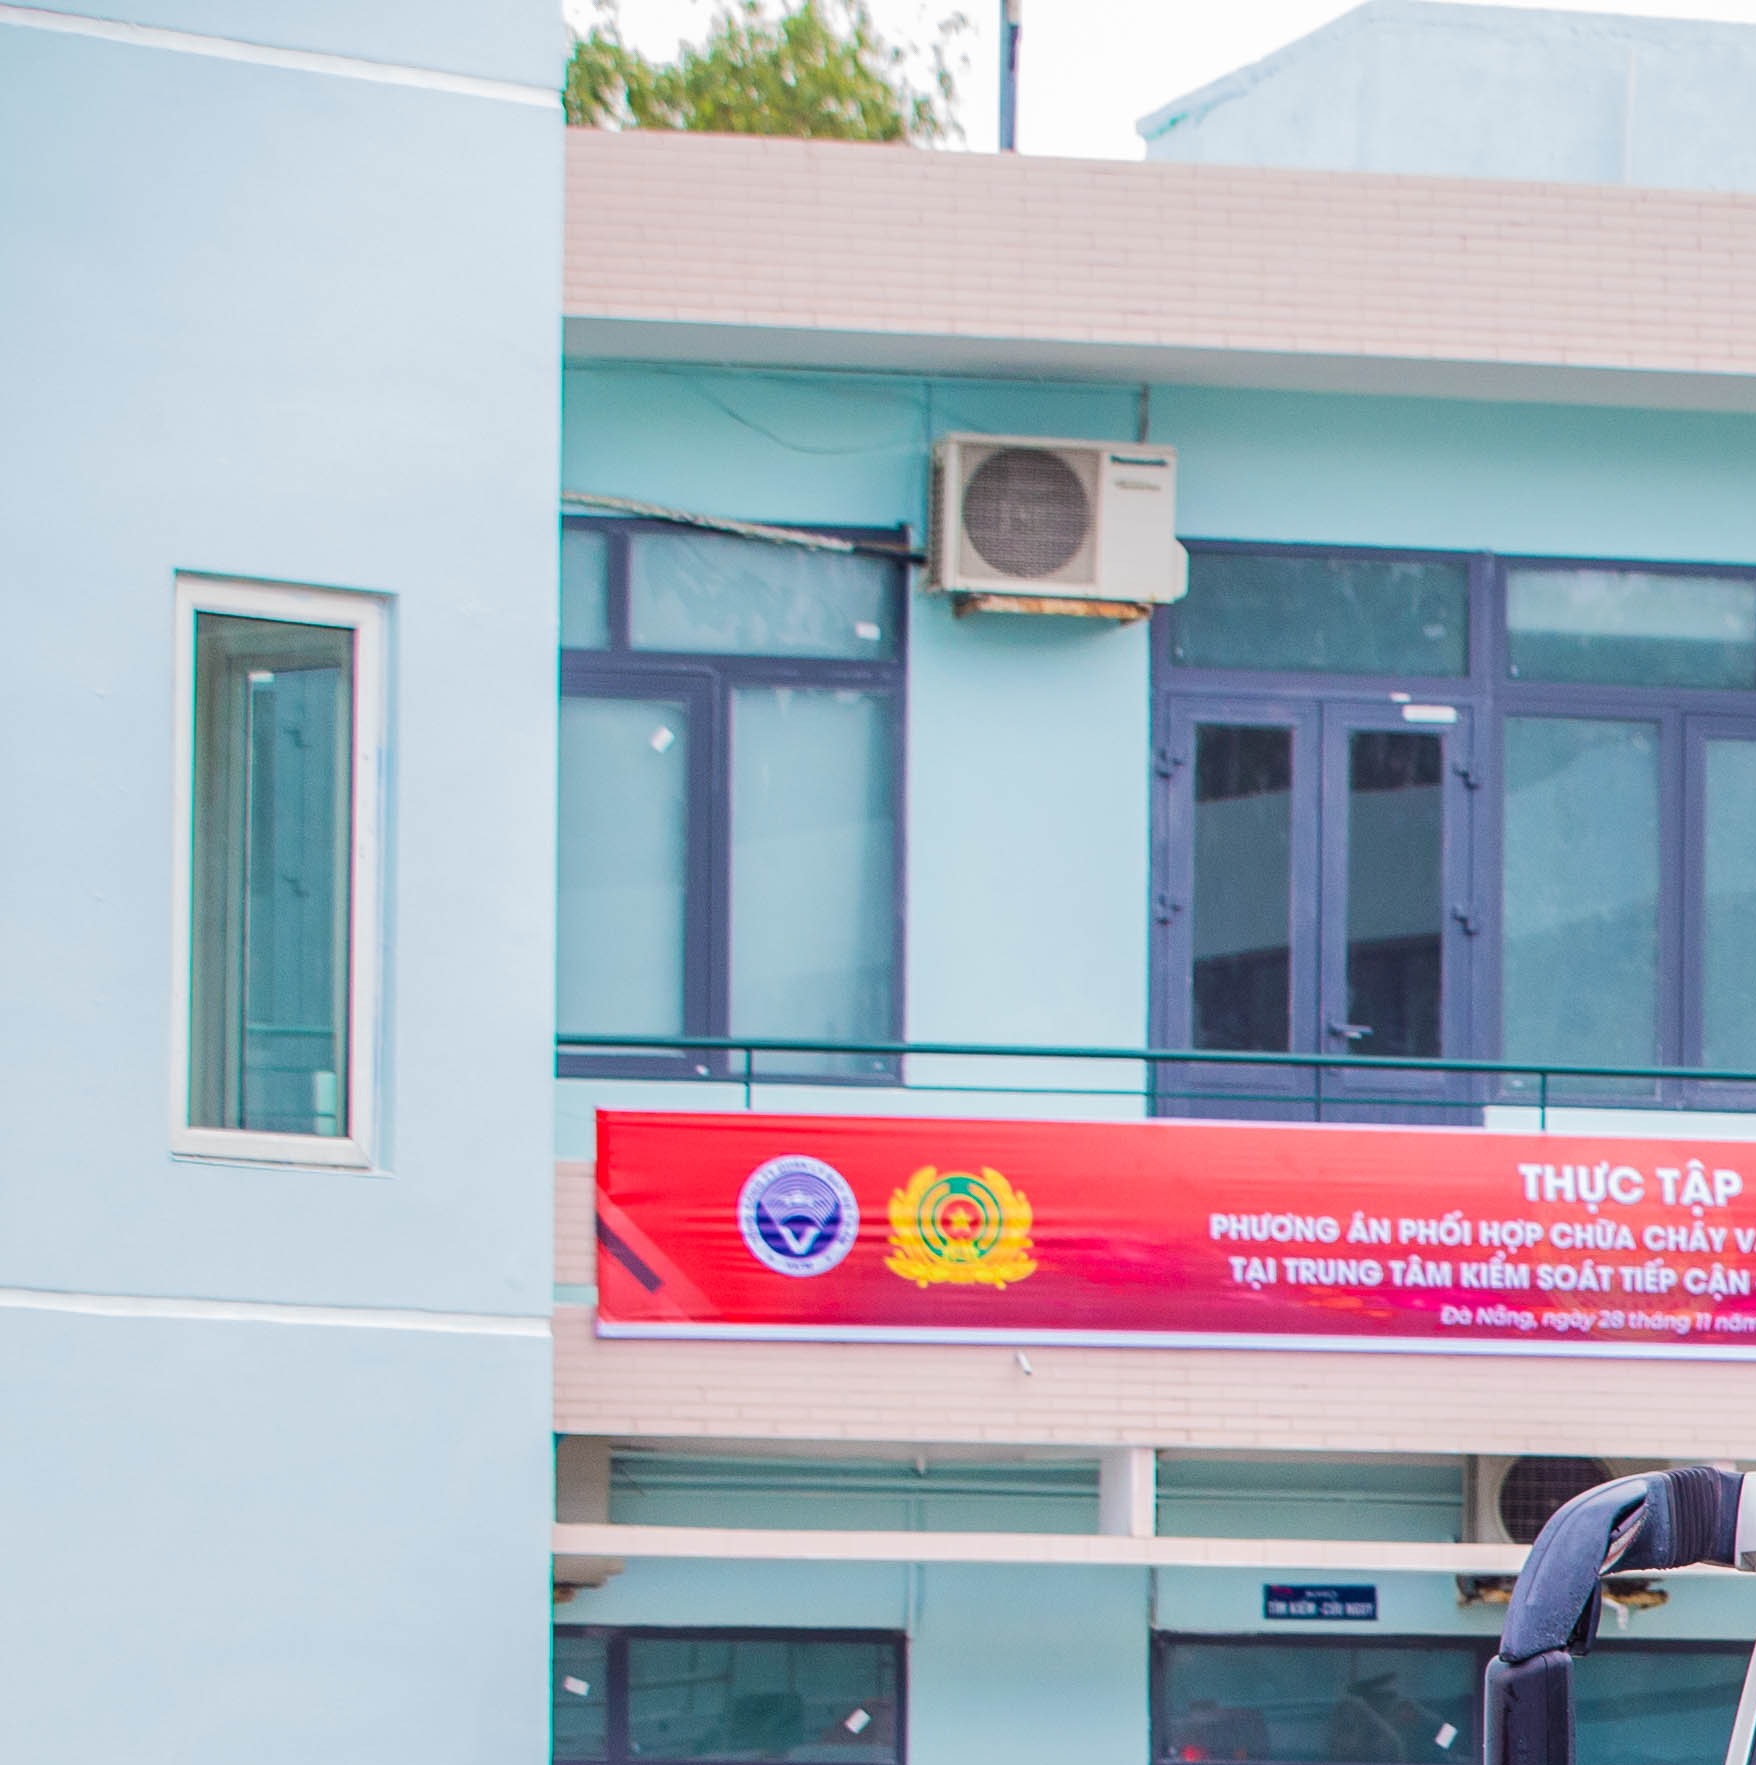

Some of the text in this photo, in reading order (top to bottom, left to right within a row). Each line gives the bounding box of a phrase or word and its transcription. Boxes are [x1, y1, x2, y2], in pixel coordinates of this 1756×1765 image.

[1517, 1158, 1744, 1217] THỰC TẬP
[1208, 1211, 1341, 1244] PHƯƠNG
[1346, 1210, 1392, 1244] ÁN
[1398, 1209, 1473, 1246] PHỐI
[1478, 1218, 1544, 1255] HỢP
[1550, 1217, 1637, 1250] CHỮA
[1643, 1220, 1727, 1253] CHÁY
[1228, 1255, 1277, 1290] TẠI
[1281, 1256, 1384, 1286] TRUNG
[1387, 1253, 1453, 1288] TÂM
[1459, 1249, 1531, 1290] KIỂM
[1535, 1258, 1615, 1291] SOÁT
[1618, 1258, 1678, 1294] TIẾP
[1682, 1262, 1751, 1301] CẬN
[1439, 1303, 1473, 1326] Đà
[1541, 1308, 1598, 1333] ngày
[1597, 1309, 1626, 1329] 28
[1627, 1310, 1692, 1336] tháng
[1694, 1311, 1713, 1332] 11
